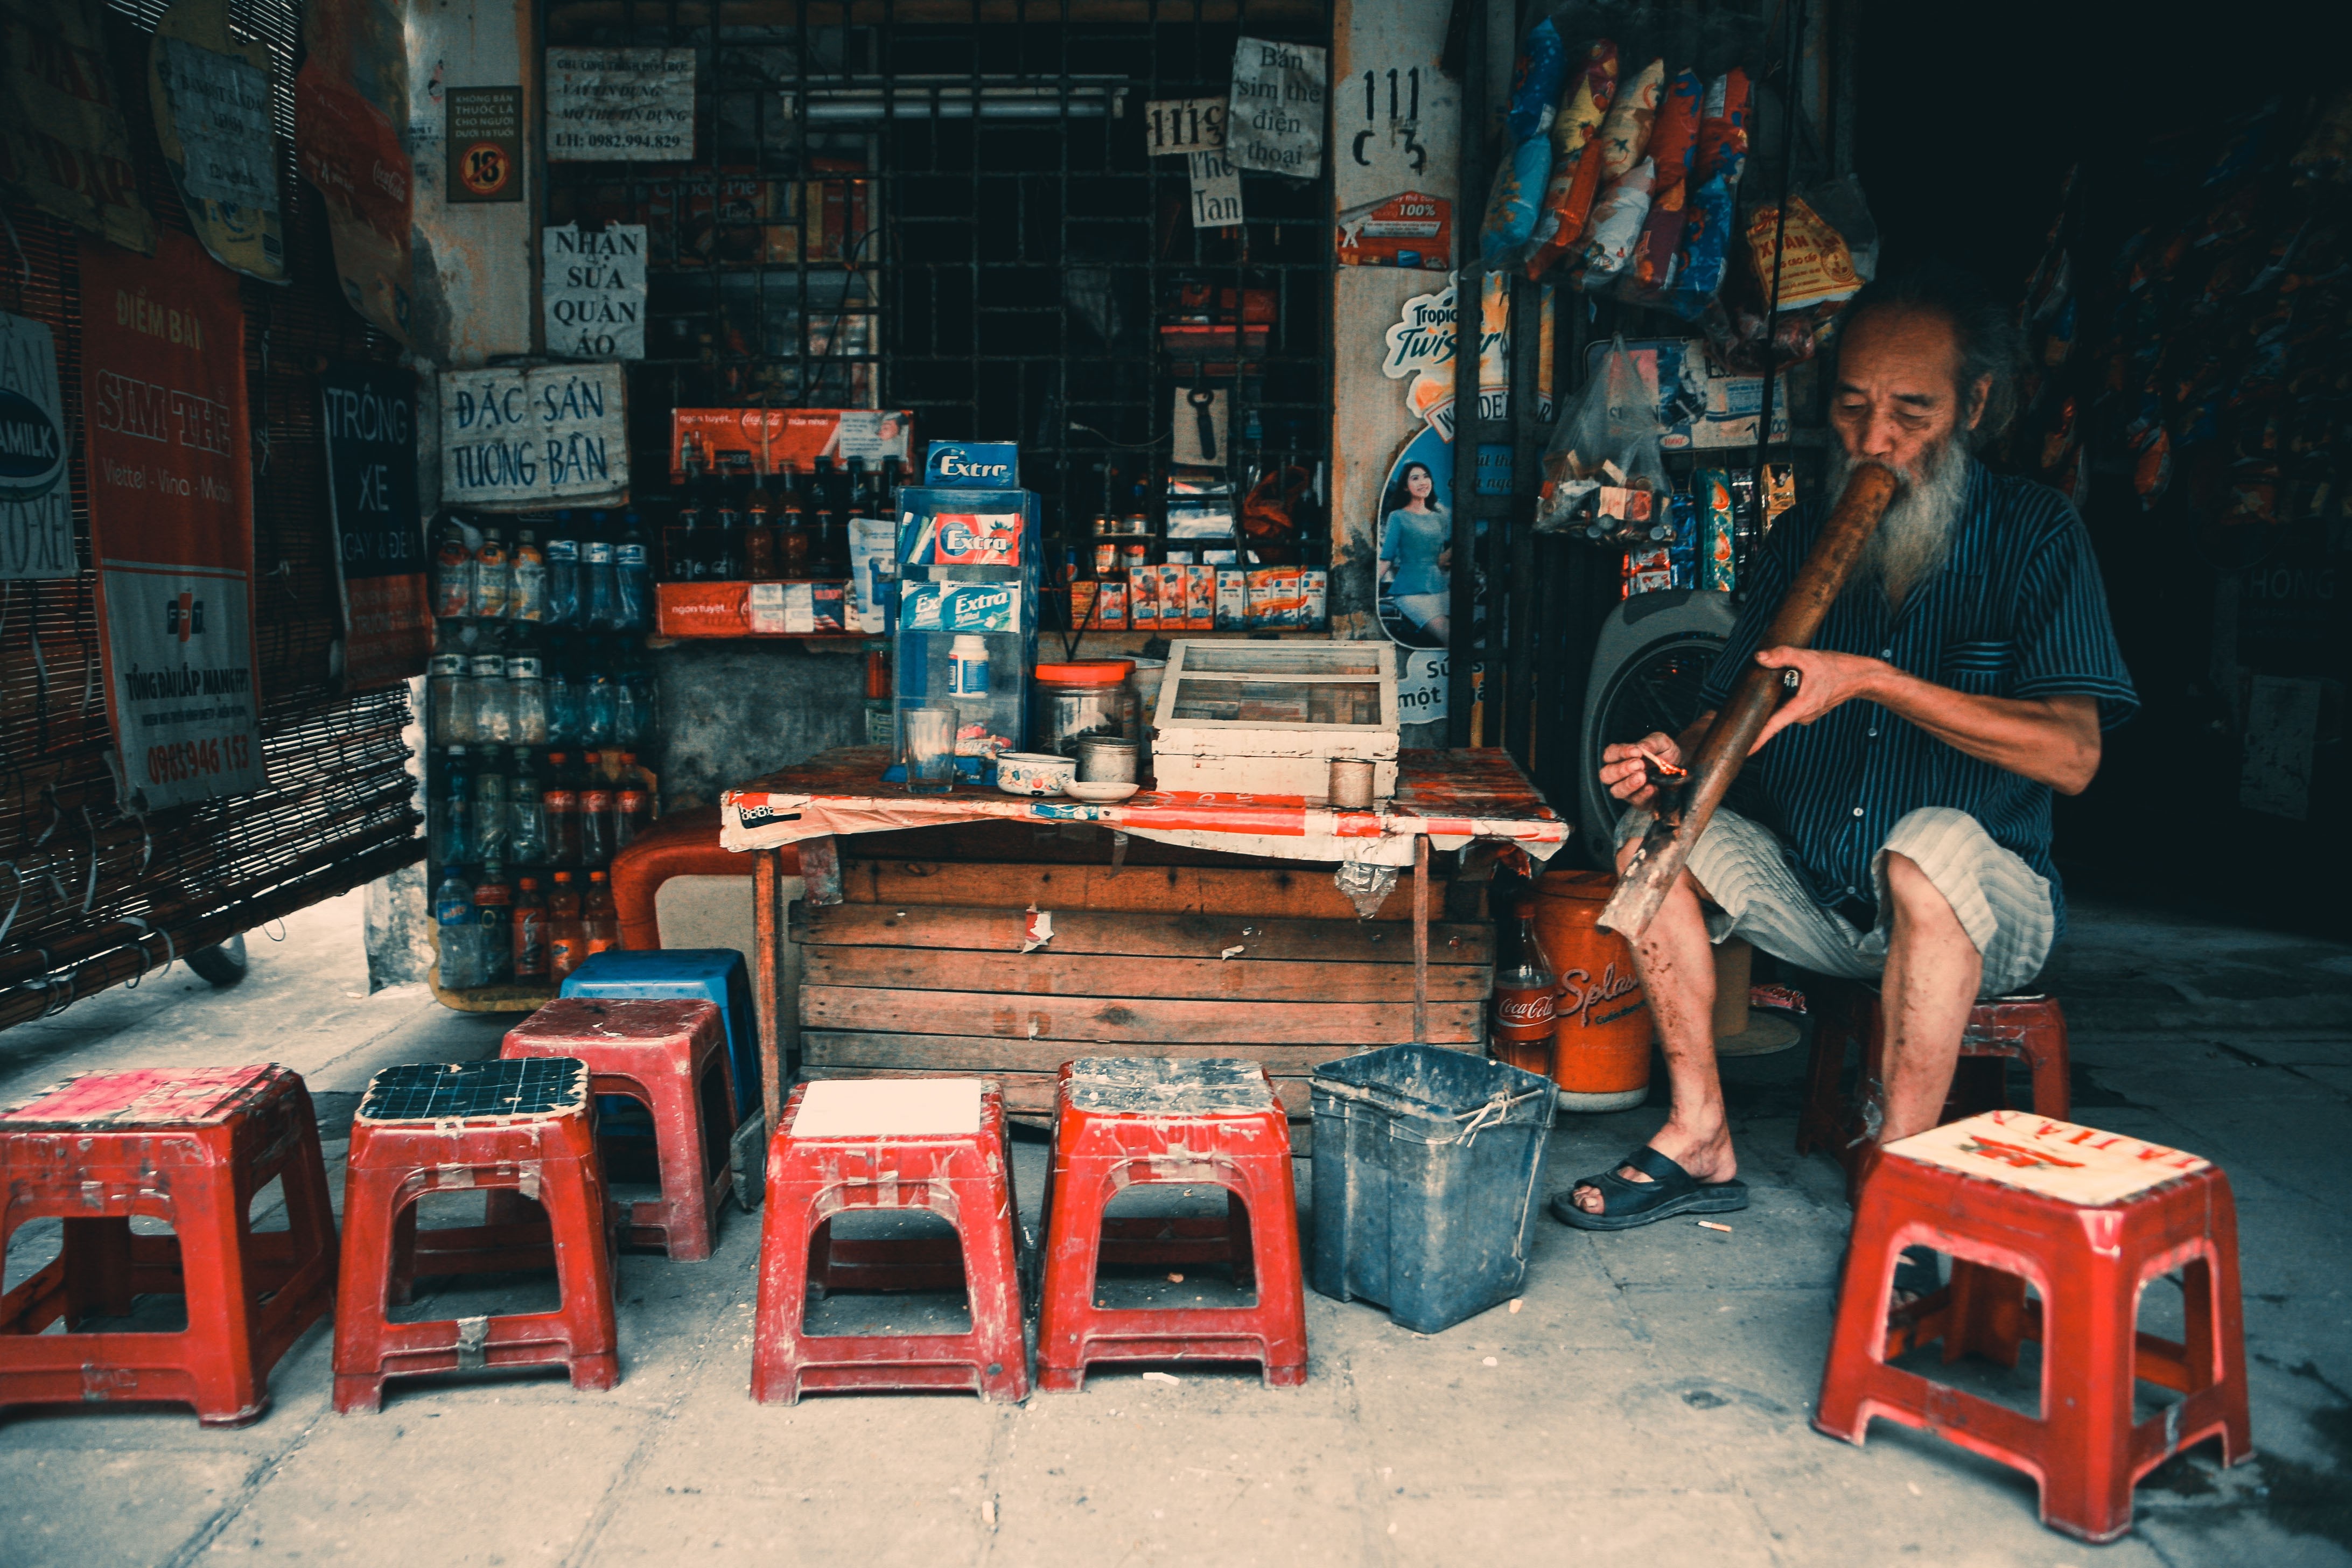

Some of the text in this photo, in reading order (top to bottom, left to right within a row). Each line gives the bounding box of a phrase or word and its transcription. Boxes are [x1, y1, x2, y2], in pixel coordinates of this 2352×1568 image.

[1259, 46, 1304, 70] Bán
[456, 93, 491, 103] KHÔNG
[1238, 77, 1277, 99] sim
[456, 104, 495, 115] THUỐC
[456, 117, 478, 126] CHO
[1251, 108, 1300, 137] điện
[556, 134, 681, 148] LH: 0982.994.829
[1248, 141, 1303, 169] thoại
[471, 151, 499, 183] 18
[1400, 204, 1436, 216] 100%
[555, 231, 638, 261] NHẬN
[116, 285, 165, 339] ĐIỂM
[554, 295, 638, 327] QUẦN
[1413, 304, 1484, 327] Tropic
[575, 327, 615, 355] ÁO
[96, 368, 167, 443] SIM
[327, 381, 408, 445] TRÔNG
[455, 375, 604, 429] ĐẶC SẢN
[102, 457, 147, 490] Viettel
[157, 468, 191, 496] Vina
[941, 456, 1007, 477] Extra
[358, 464, 390, 512] XE
[947, 530, 1007, 551] Extra
[955, 592, 1010, 614] Extra
[125, 663, 158, 701] TỔNG
[1398, 687, 1441, 710] một
[186, 737, 220, 777] 946
[223, 734, 249, 771] 153
[1500, 996, 1555, 1019] Coca-Cola
